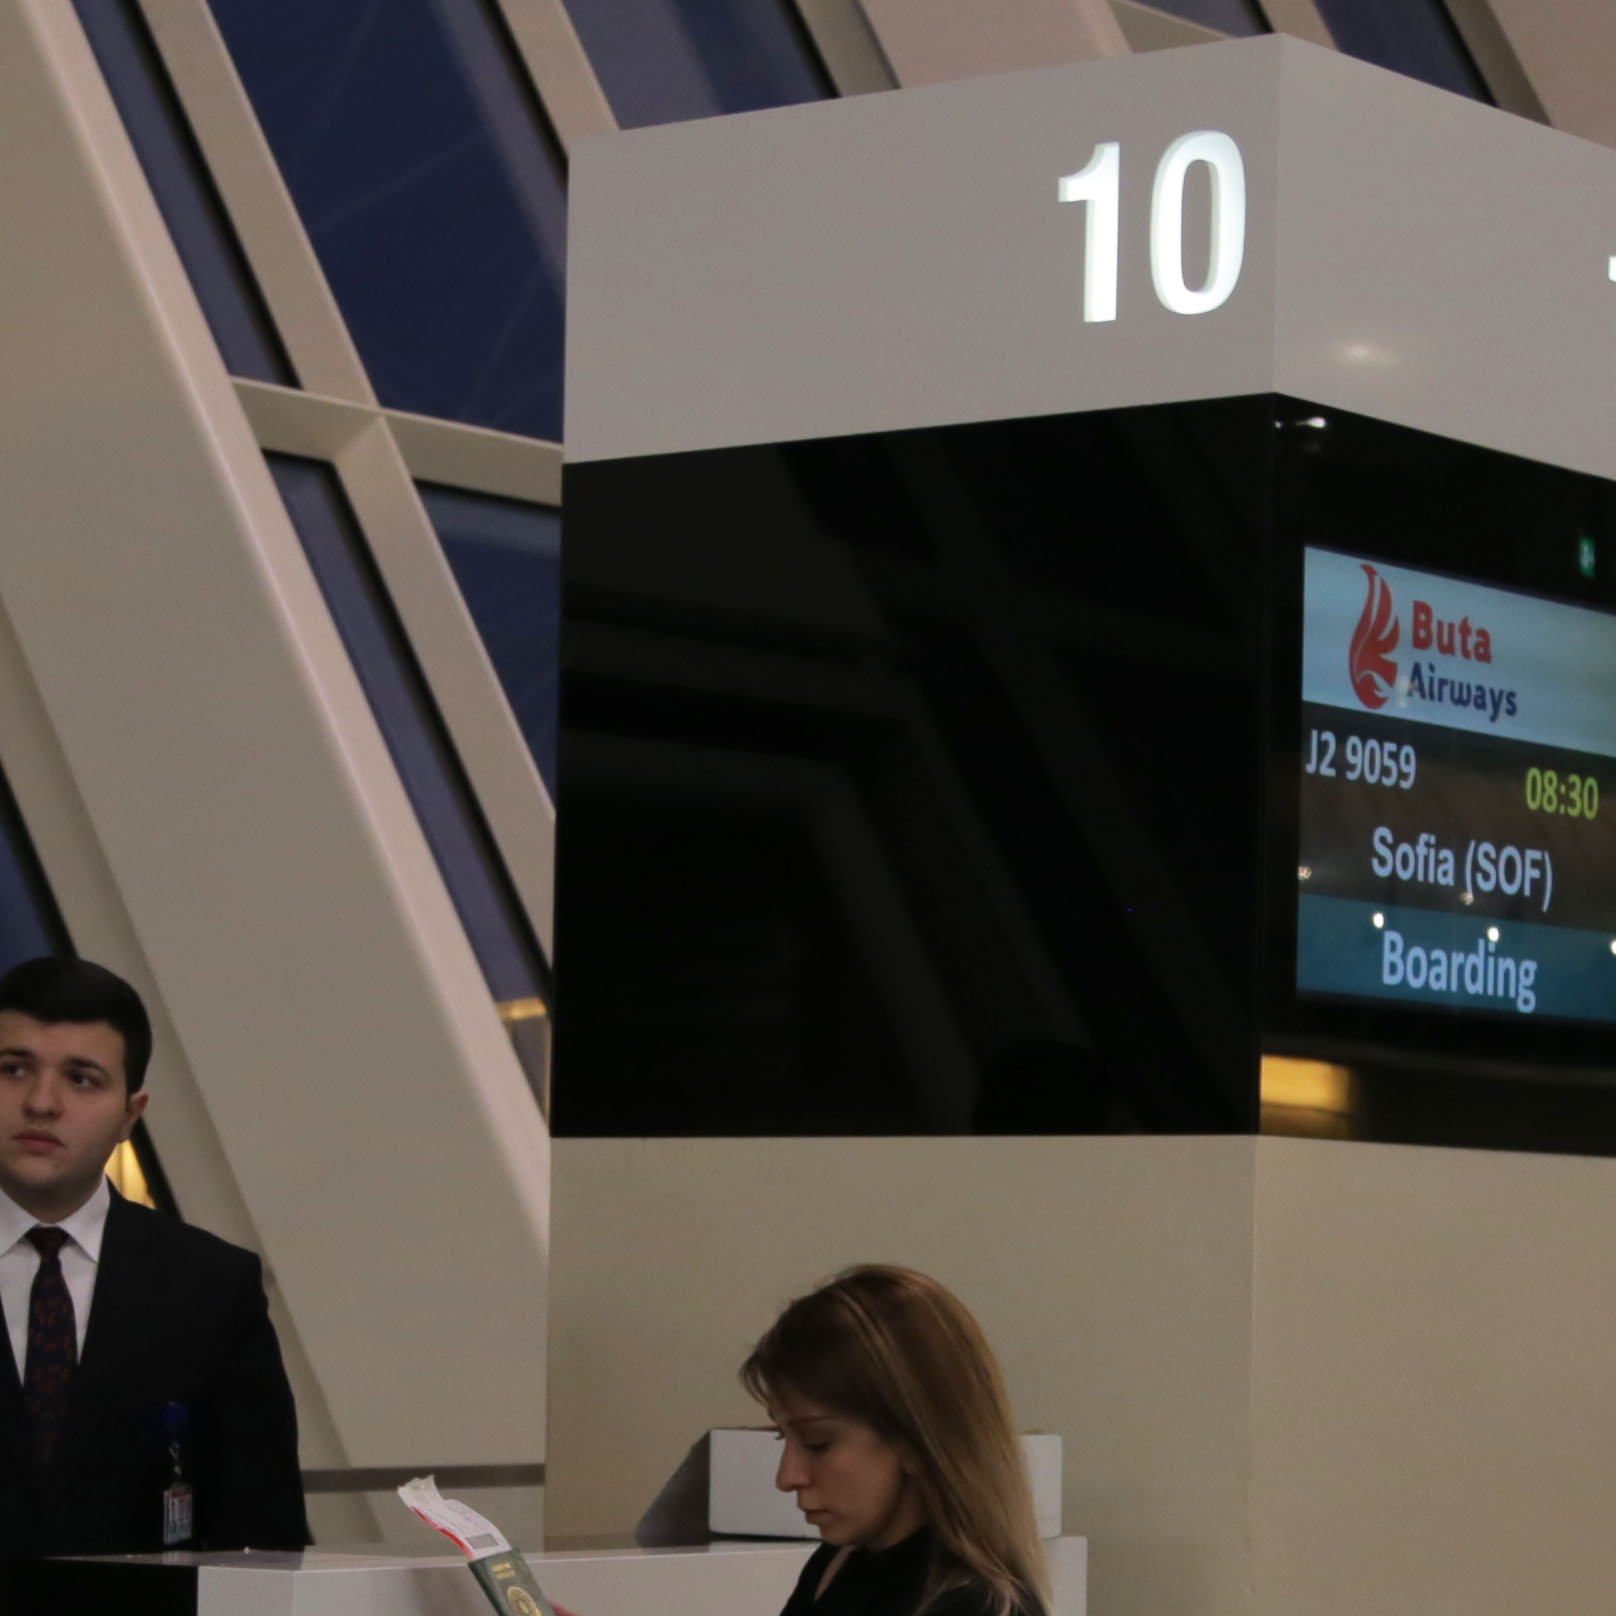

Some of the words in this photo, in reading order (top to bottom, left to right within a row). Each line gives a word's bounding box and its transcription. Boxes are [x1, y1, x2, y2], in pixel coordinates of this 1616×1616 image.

[1055, 129, 1247, 325] 10
[1411, 600, 1493, 664] Buta
[1406, 662, 1518, 723] Airways
[1305, 728, 1337, 777] J2
[1345, 735, 1417, 790] 9059
[1525, 767, 1599, 820] 08:30
[1371, 826, 1455, 887] Sofia
[1466, 839, 1554, 912] (SOF)
[1383, 930, 1539, 1014] Boarding
